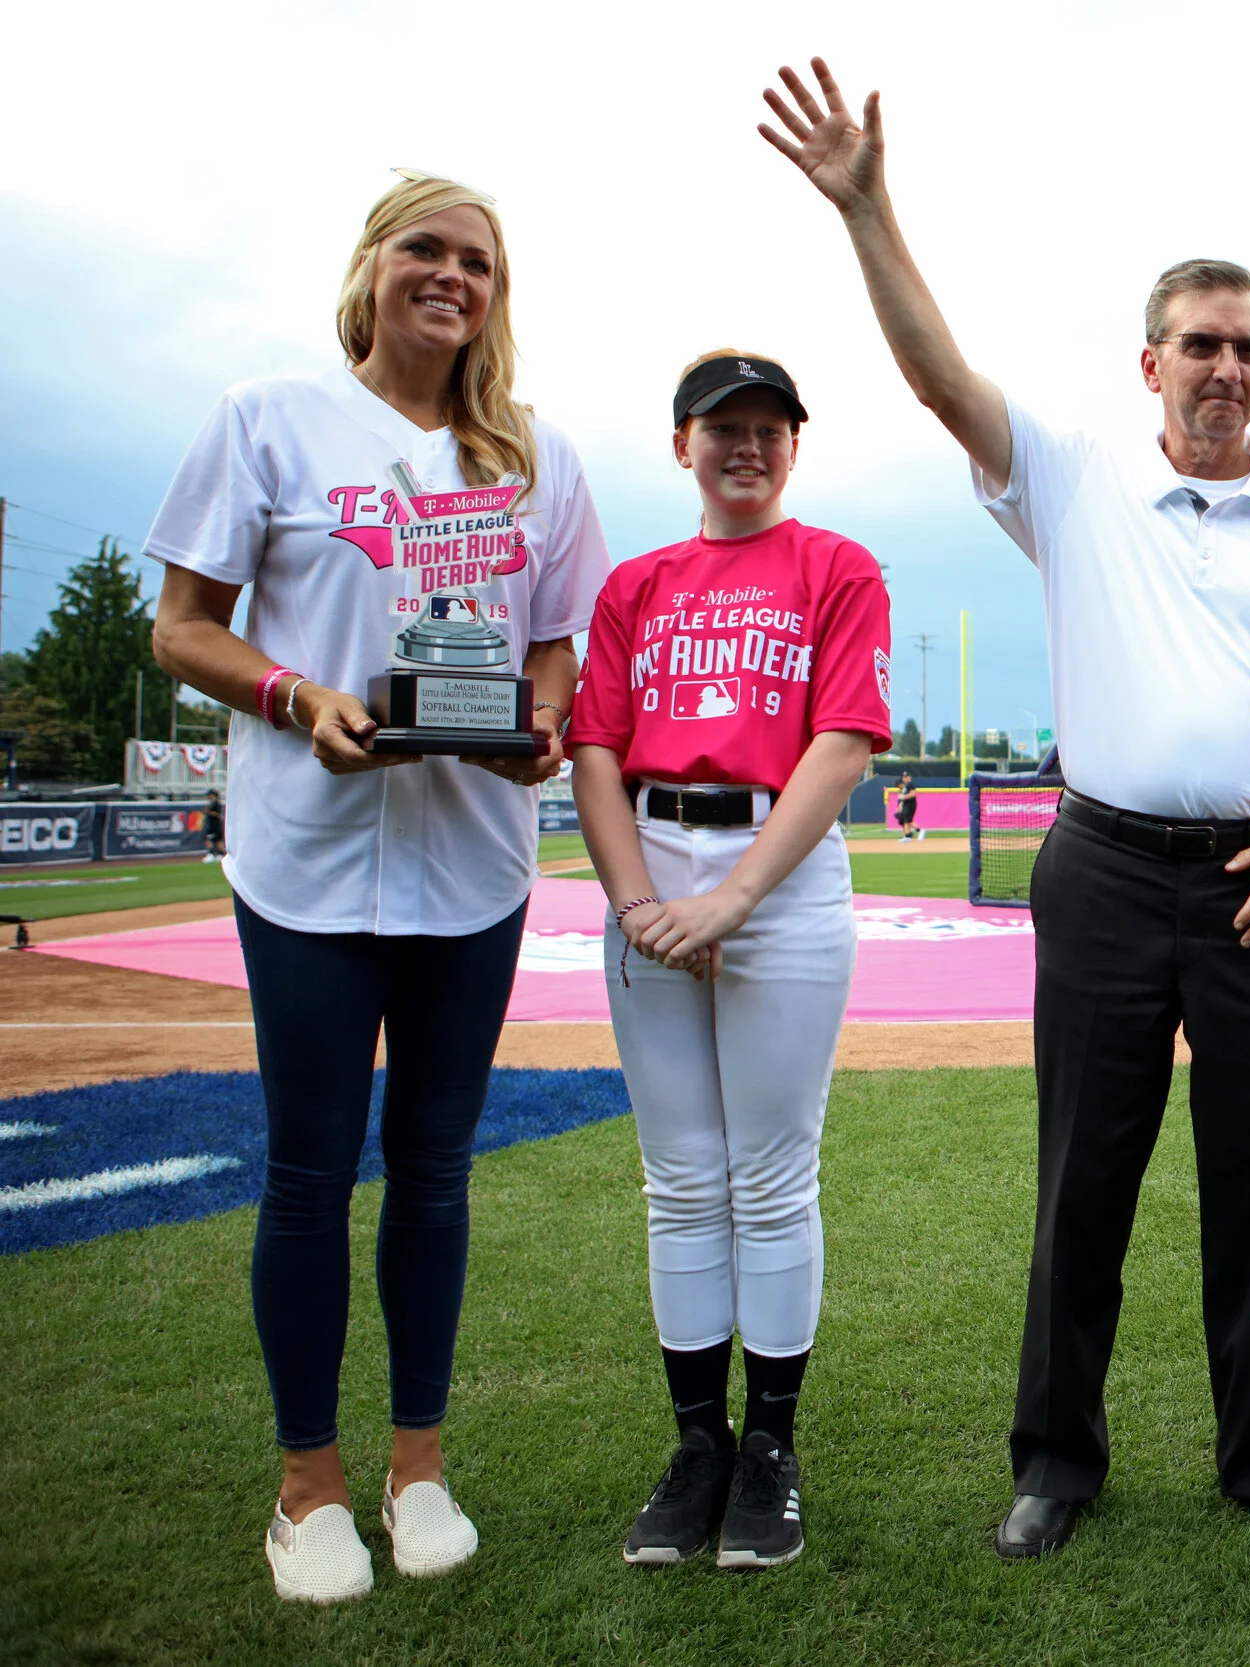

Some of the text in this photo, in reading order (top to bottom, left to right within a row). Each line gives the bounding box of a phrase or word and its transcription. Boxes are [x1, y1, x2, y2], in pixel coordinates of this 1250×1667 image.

[400, 514, 515, 540] LITTLE LEAGUE
[403, 533, 511, 568] HOME RUN
[421, 560, 490, 594] DERBY
[397, 597, 509, 619] 20 19
[712, 607, 804, 635] LEAGUE
[669, 635, 738, 676] RUN
[422, 689, 439, 697] LITTLE
[441, 690, 460, 699] LEAGUE
[480, 692, 492, 700] RUN
[494, 692, 510, 701] DERBY
[444, 682, 489, 692] T-MOBILE
[751, 686, 782, 716] 19
[422, 701, 510, 714] SOFTBALL CHAMPION
[0, 817, 79, 852] EICO
